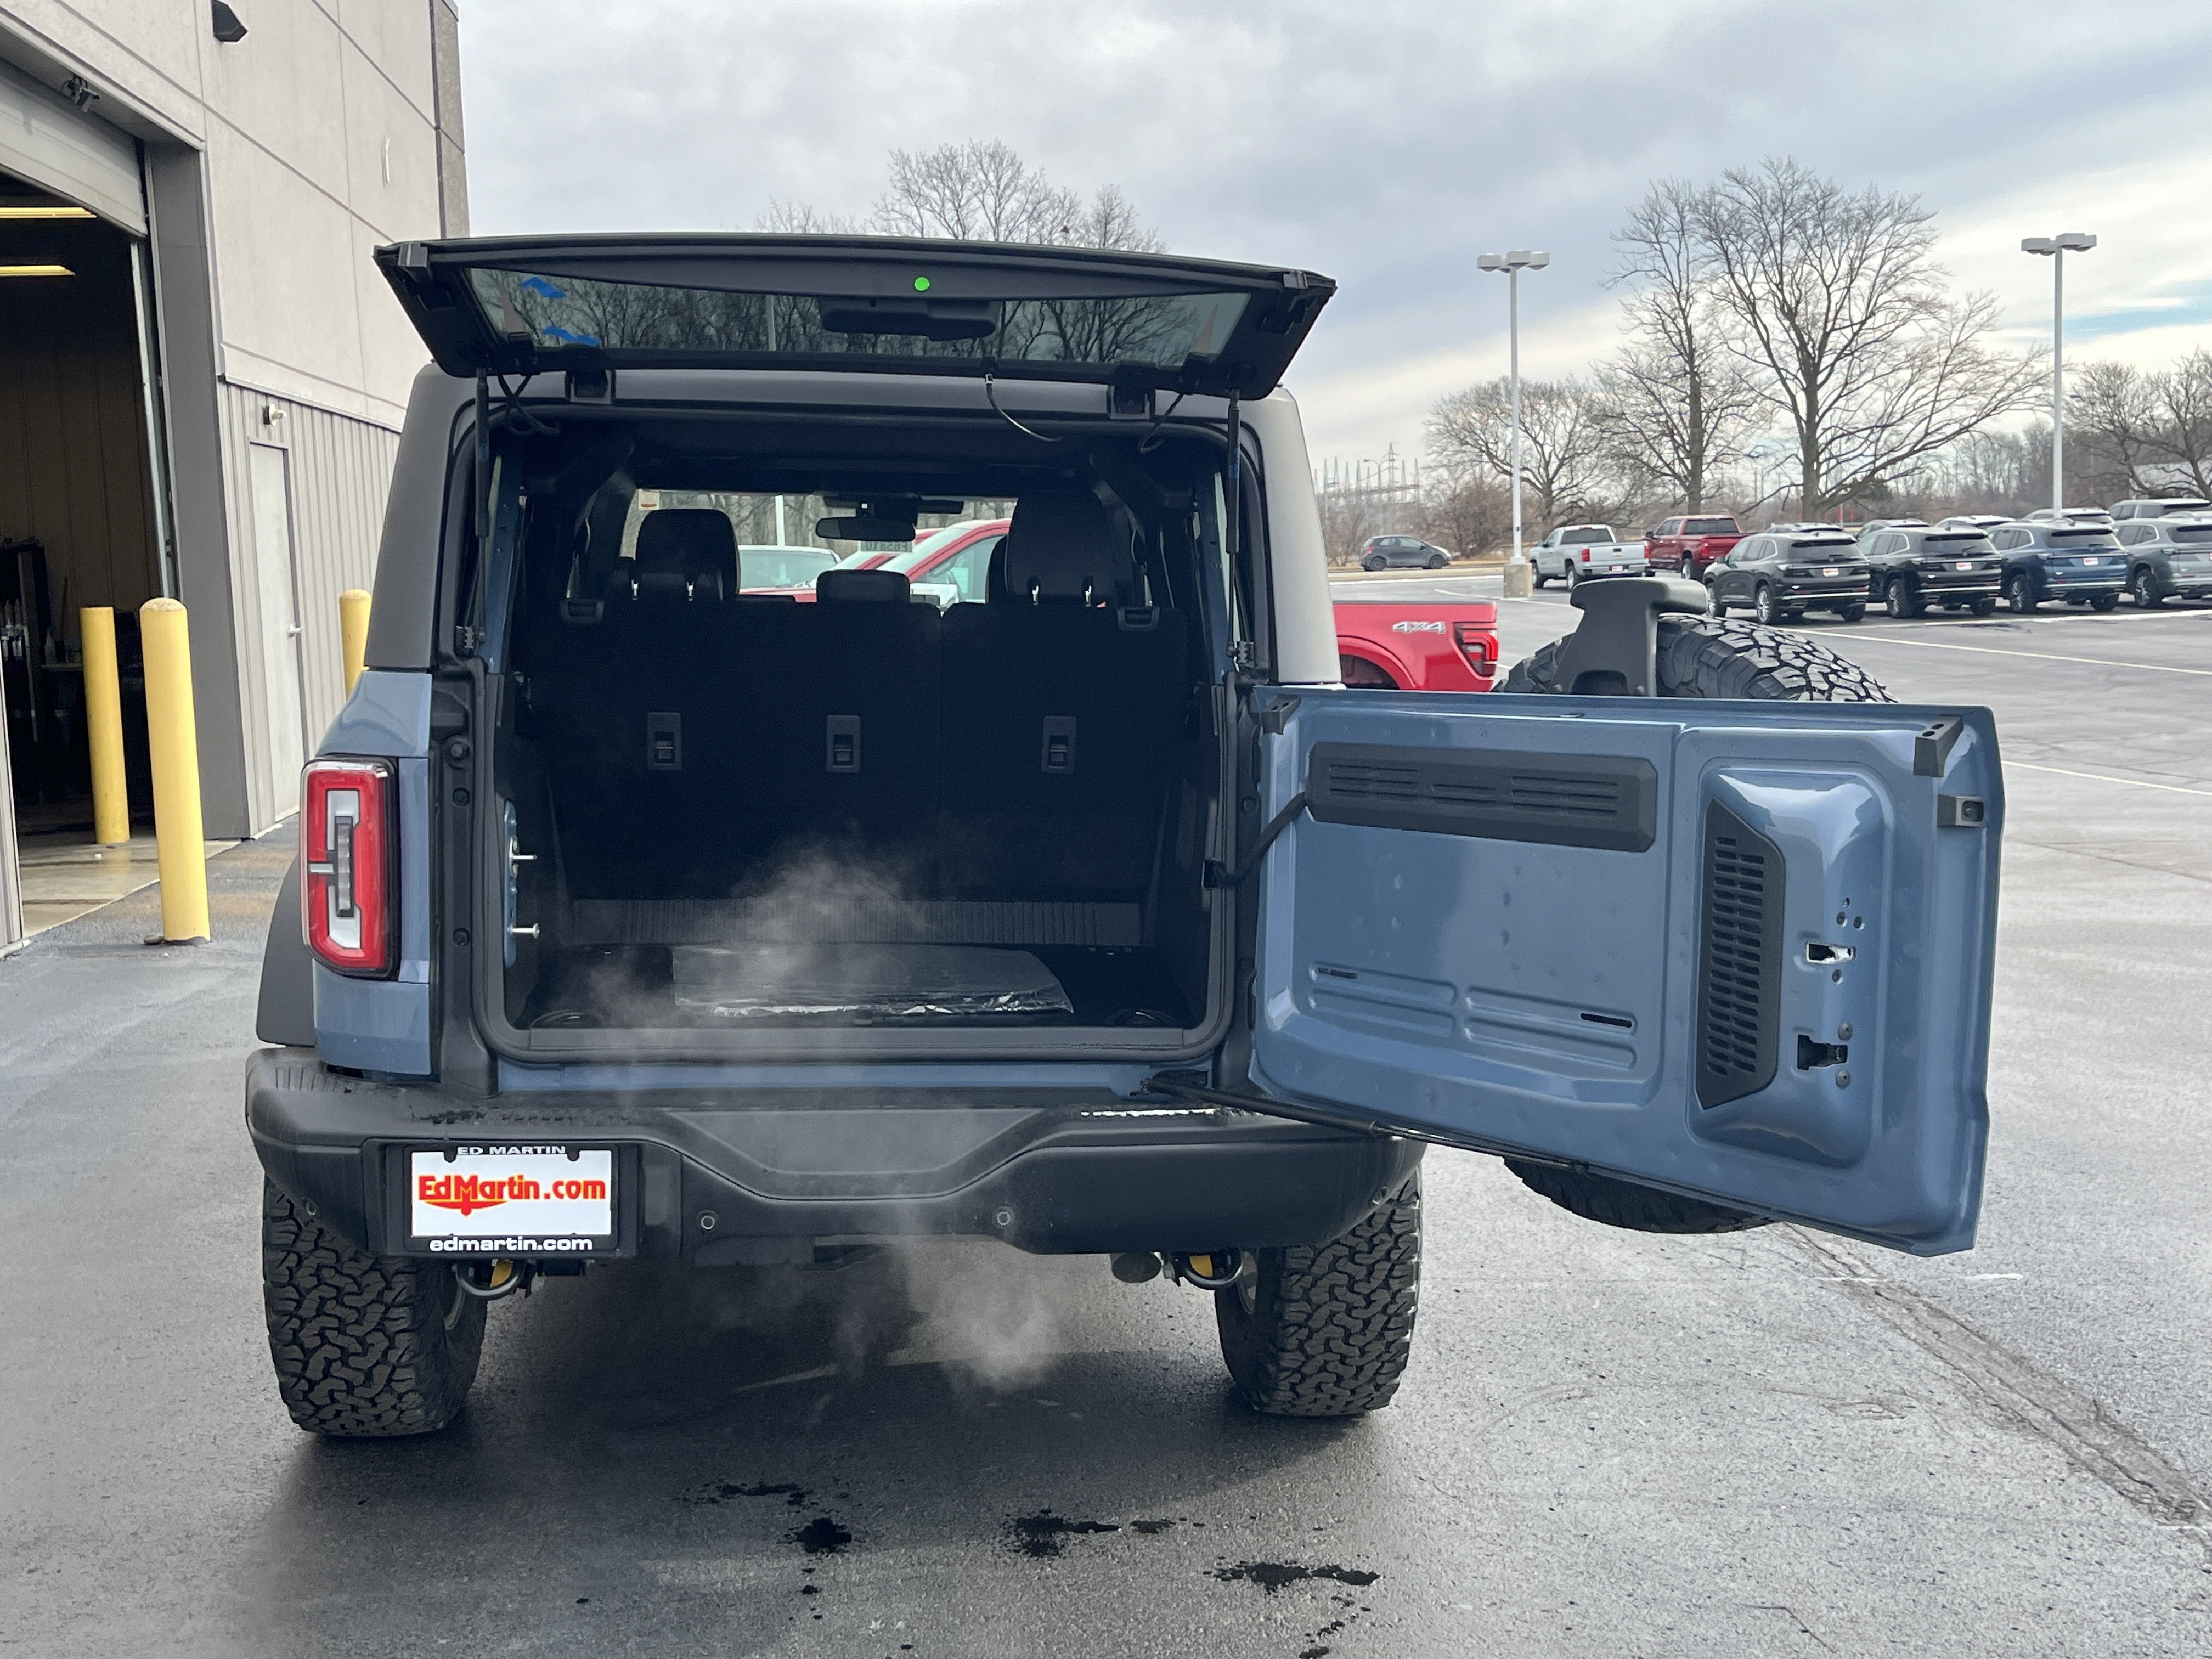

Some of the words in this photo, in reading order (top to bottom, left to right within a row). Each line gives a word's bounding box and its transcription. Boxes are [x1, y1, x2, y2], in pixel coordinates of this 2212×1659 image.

[457, 1147, 483, 1155] ED
[489, 1146, 566, 1155] MARTIN
[419, 1174, 606, 1201] EdMartin.com
[430, 1236, 592, 1251] edmartin.com
